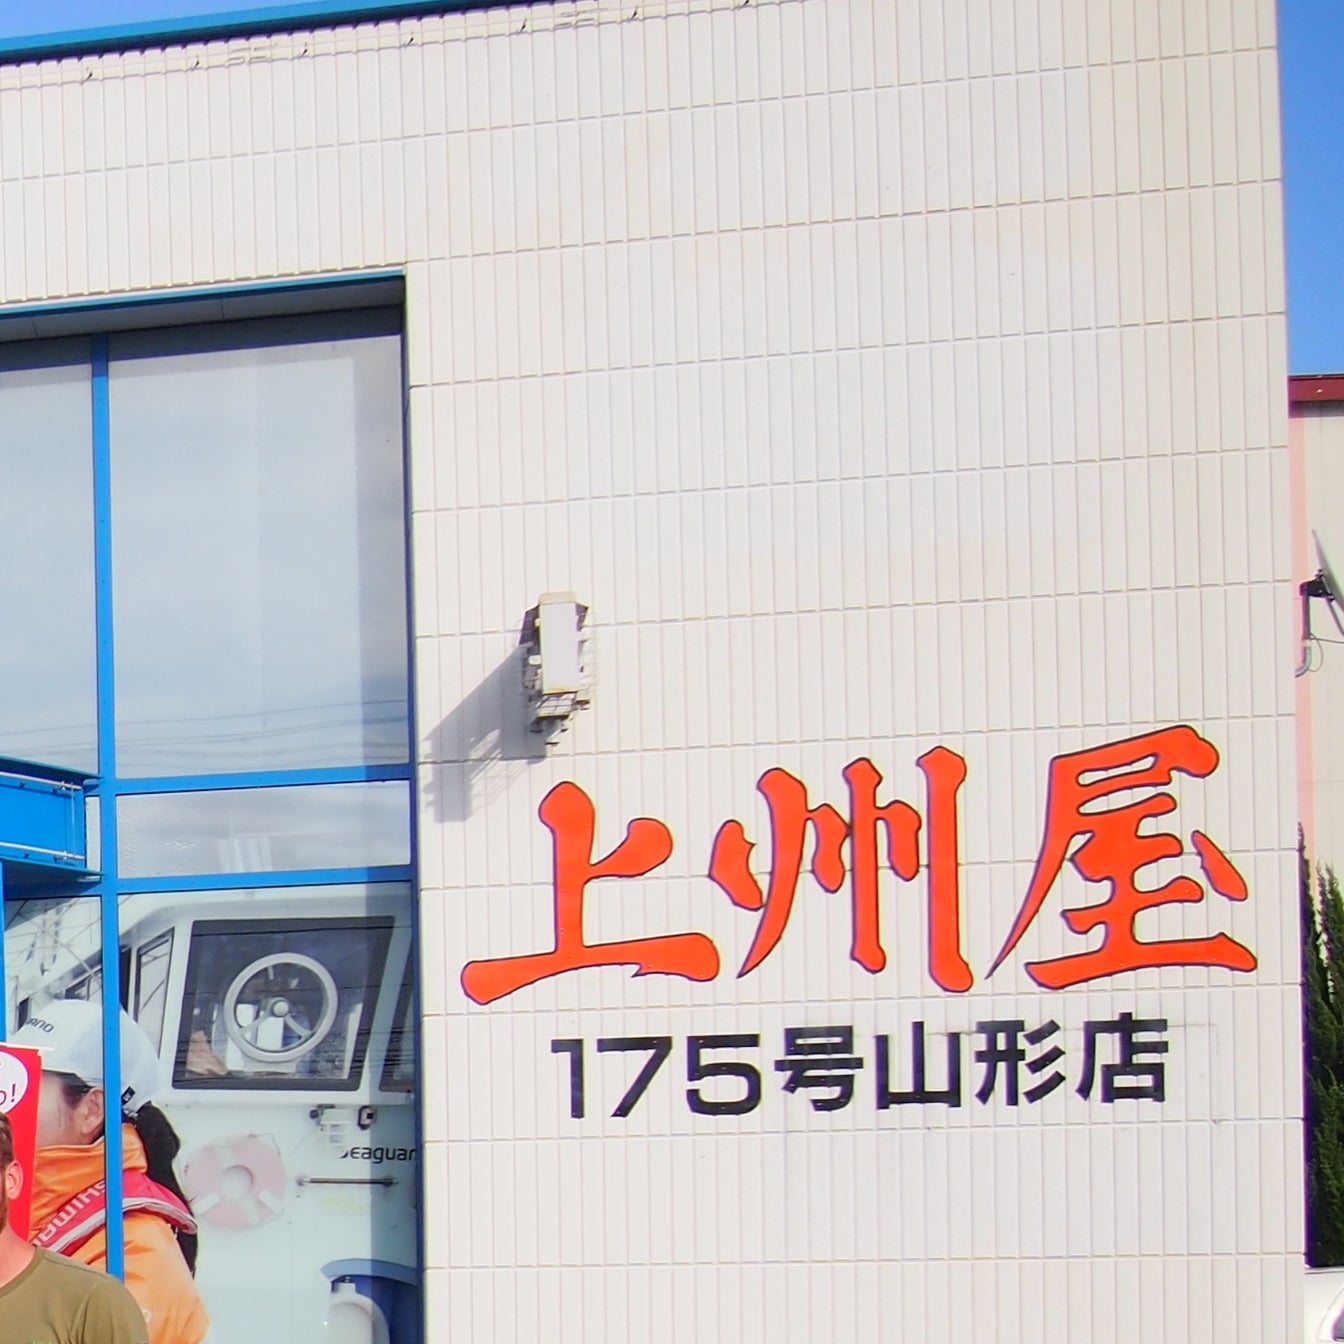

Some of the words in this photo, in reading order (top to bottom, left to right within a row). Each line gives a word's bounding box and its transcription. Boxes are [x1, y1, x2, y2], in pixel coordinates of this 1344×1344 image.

[460, 724, 1258, 1005] 上州屋
[550, 1012, 1170, 1119] 175号山形店
